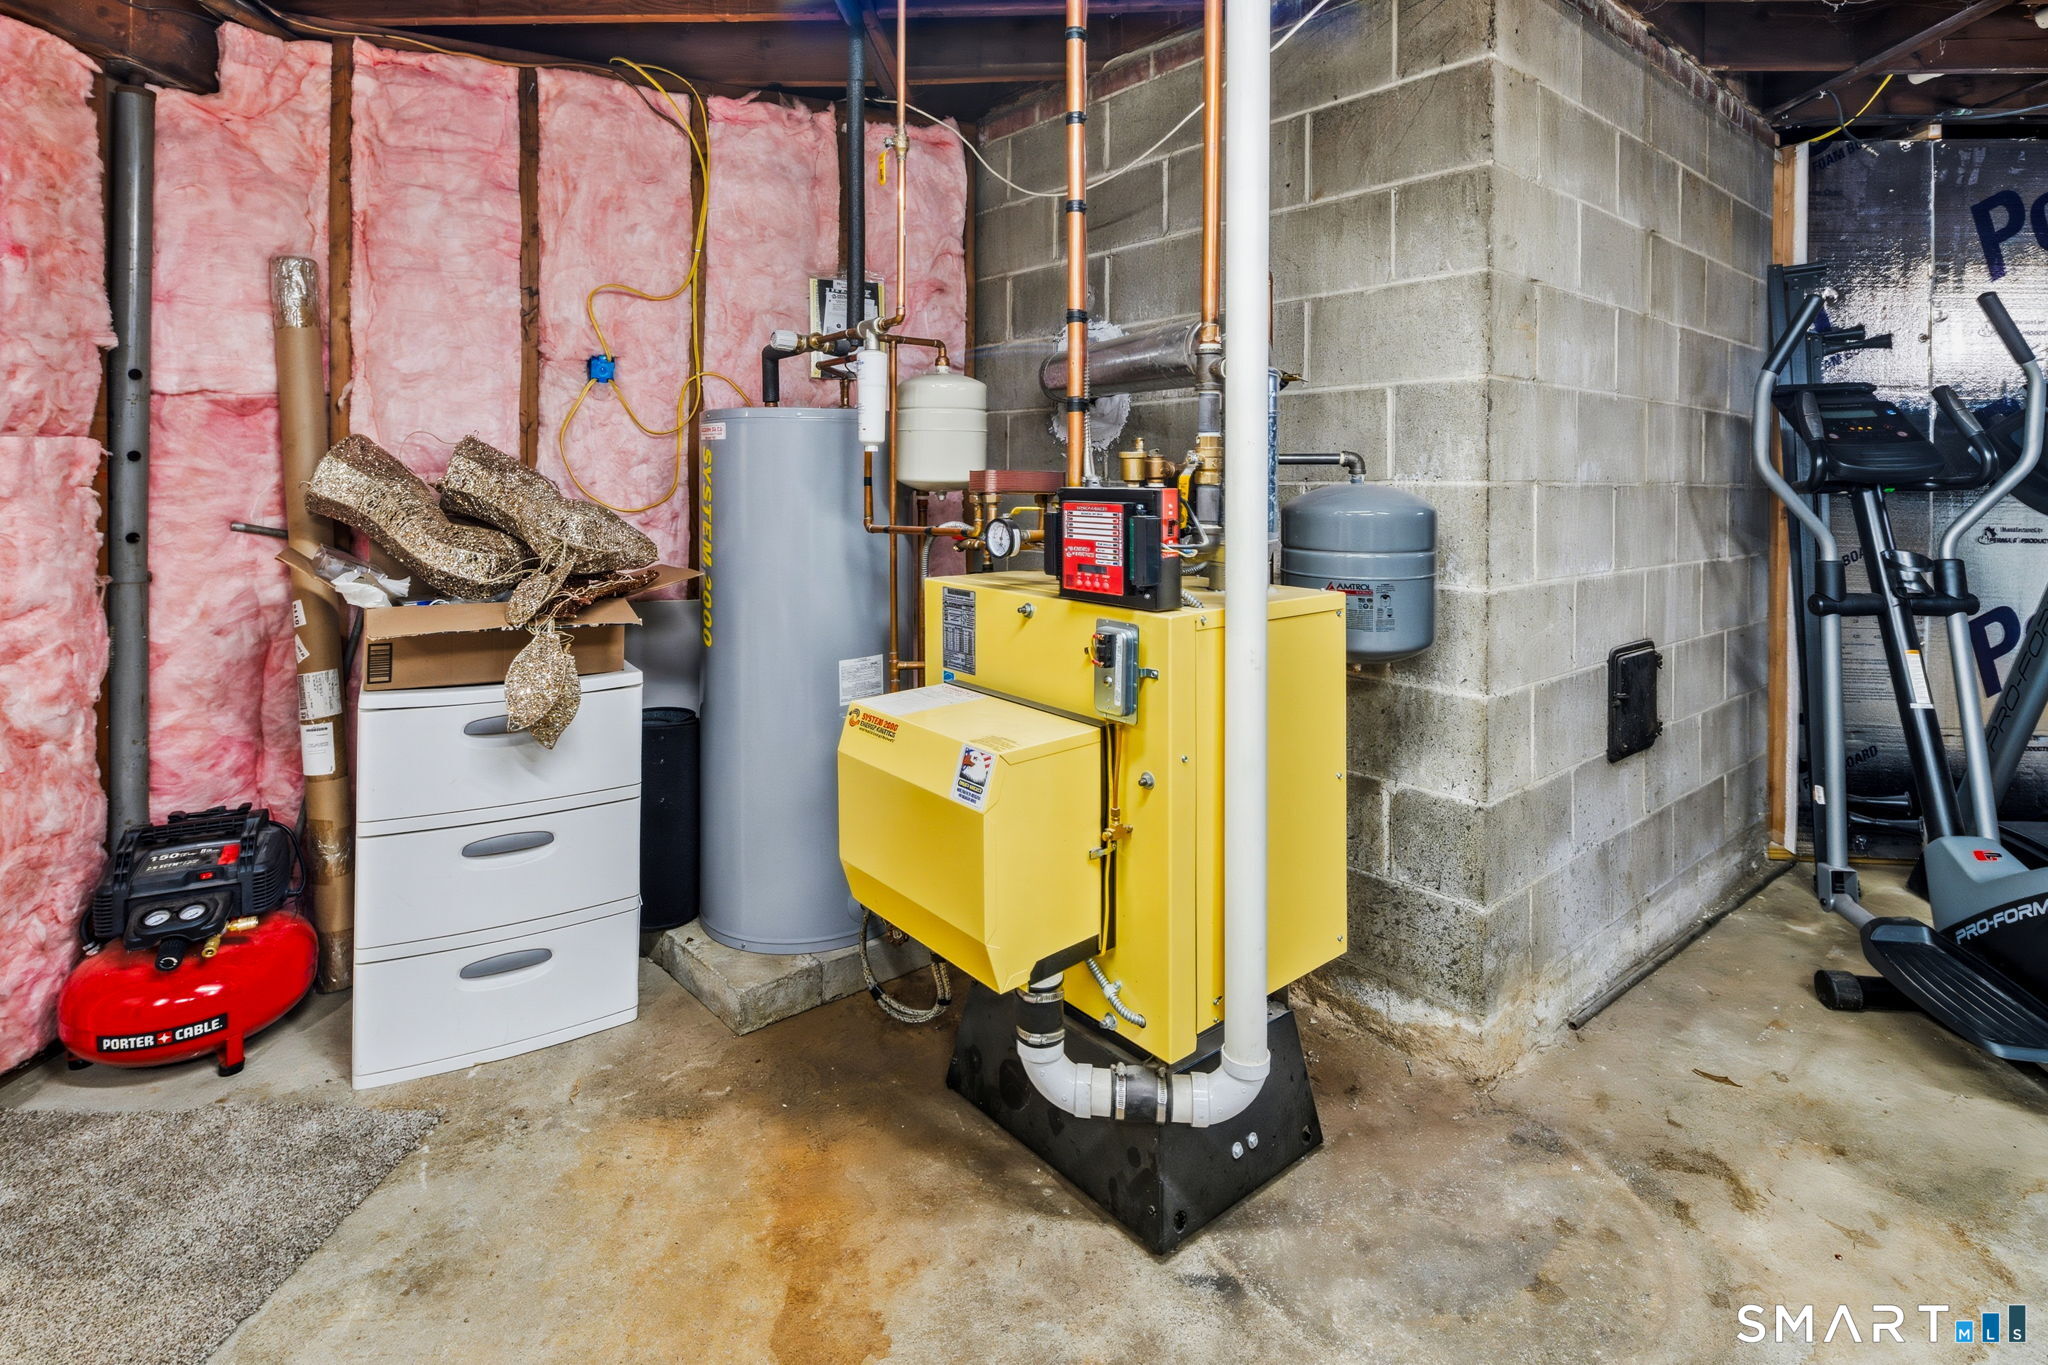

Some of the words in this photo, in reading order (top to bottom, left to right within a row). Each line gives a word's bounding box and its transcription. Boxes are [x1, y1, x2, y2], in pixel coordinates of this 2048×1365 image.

[702, 447, 713, 568] SYSTEM
[1336, 583, 1371, 591] AMTROL
[702, 576, 713, 648] 2000
[102, 1035, 155, 1050] PORTER
